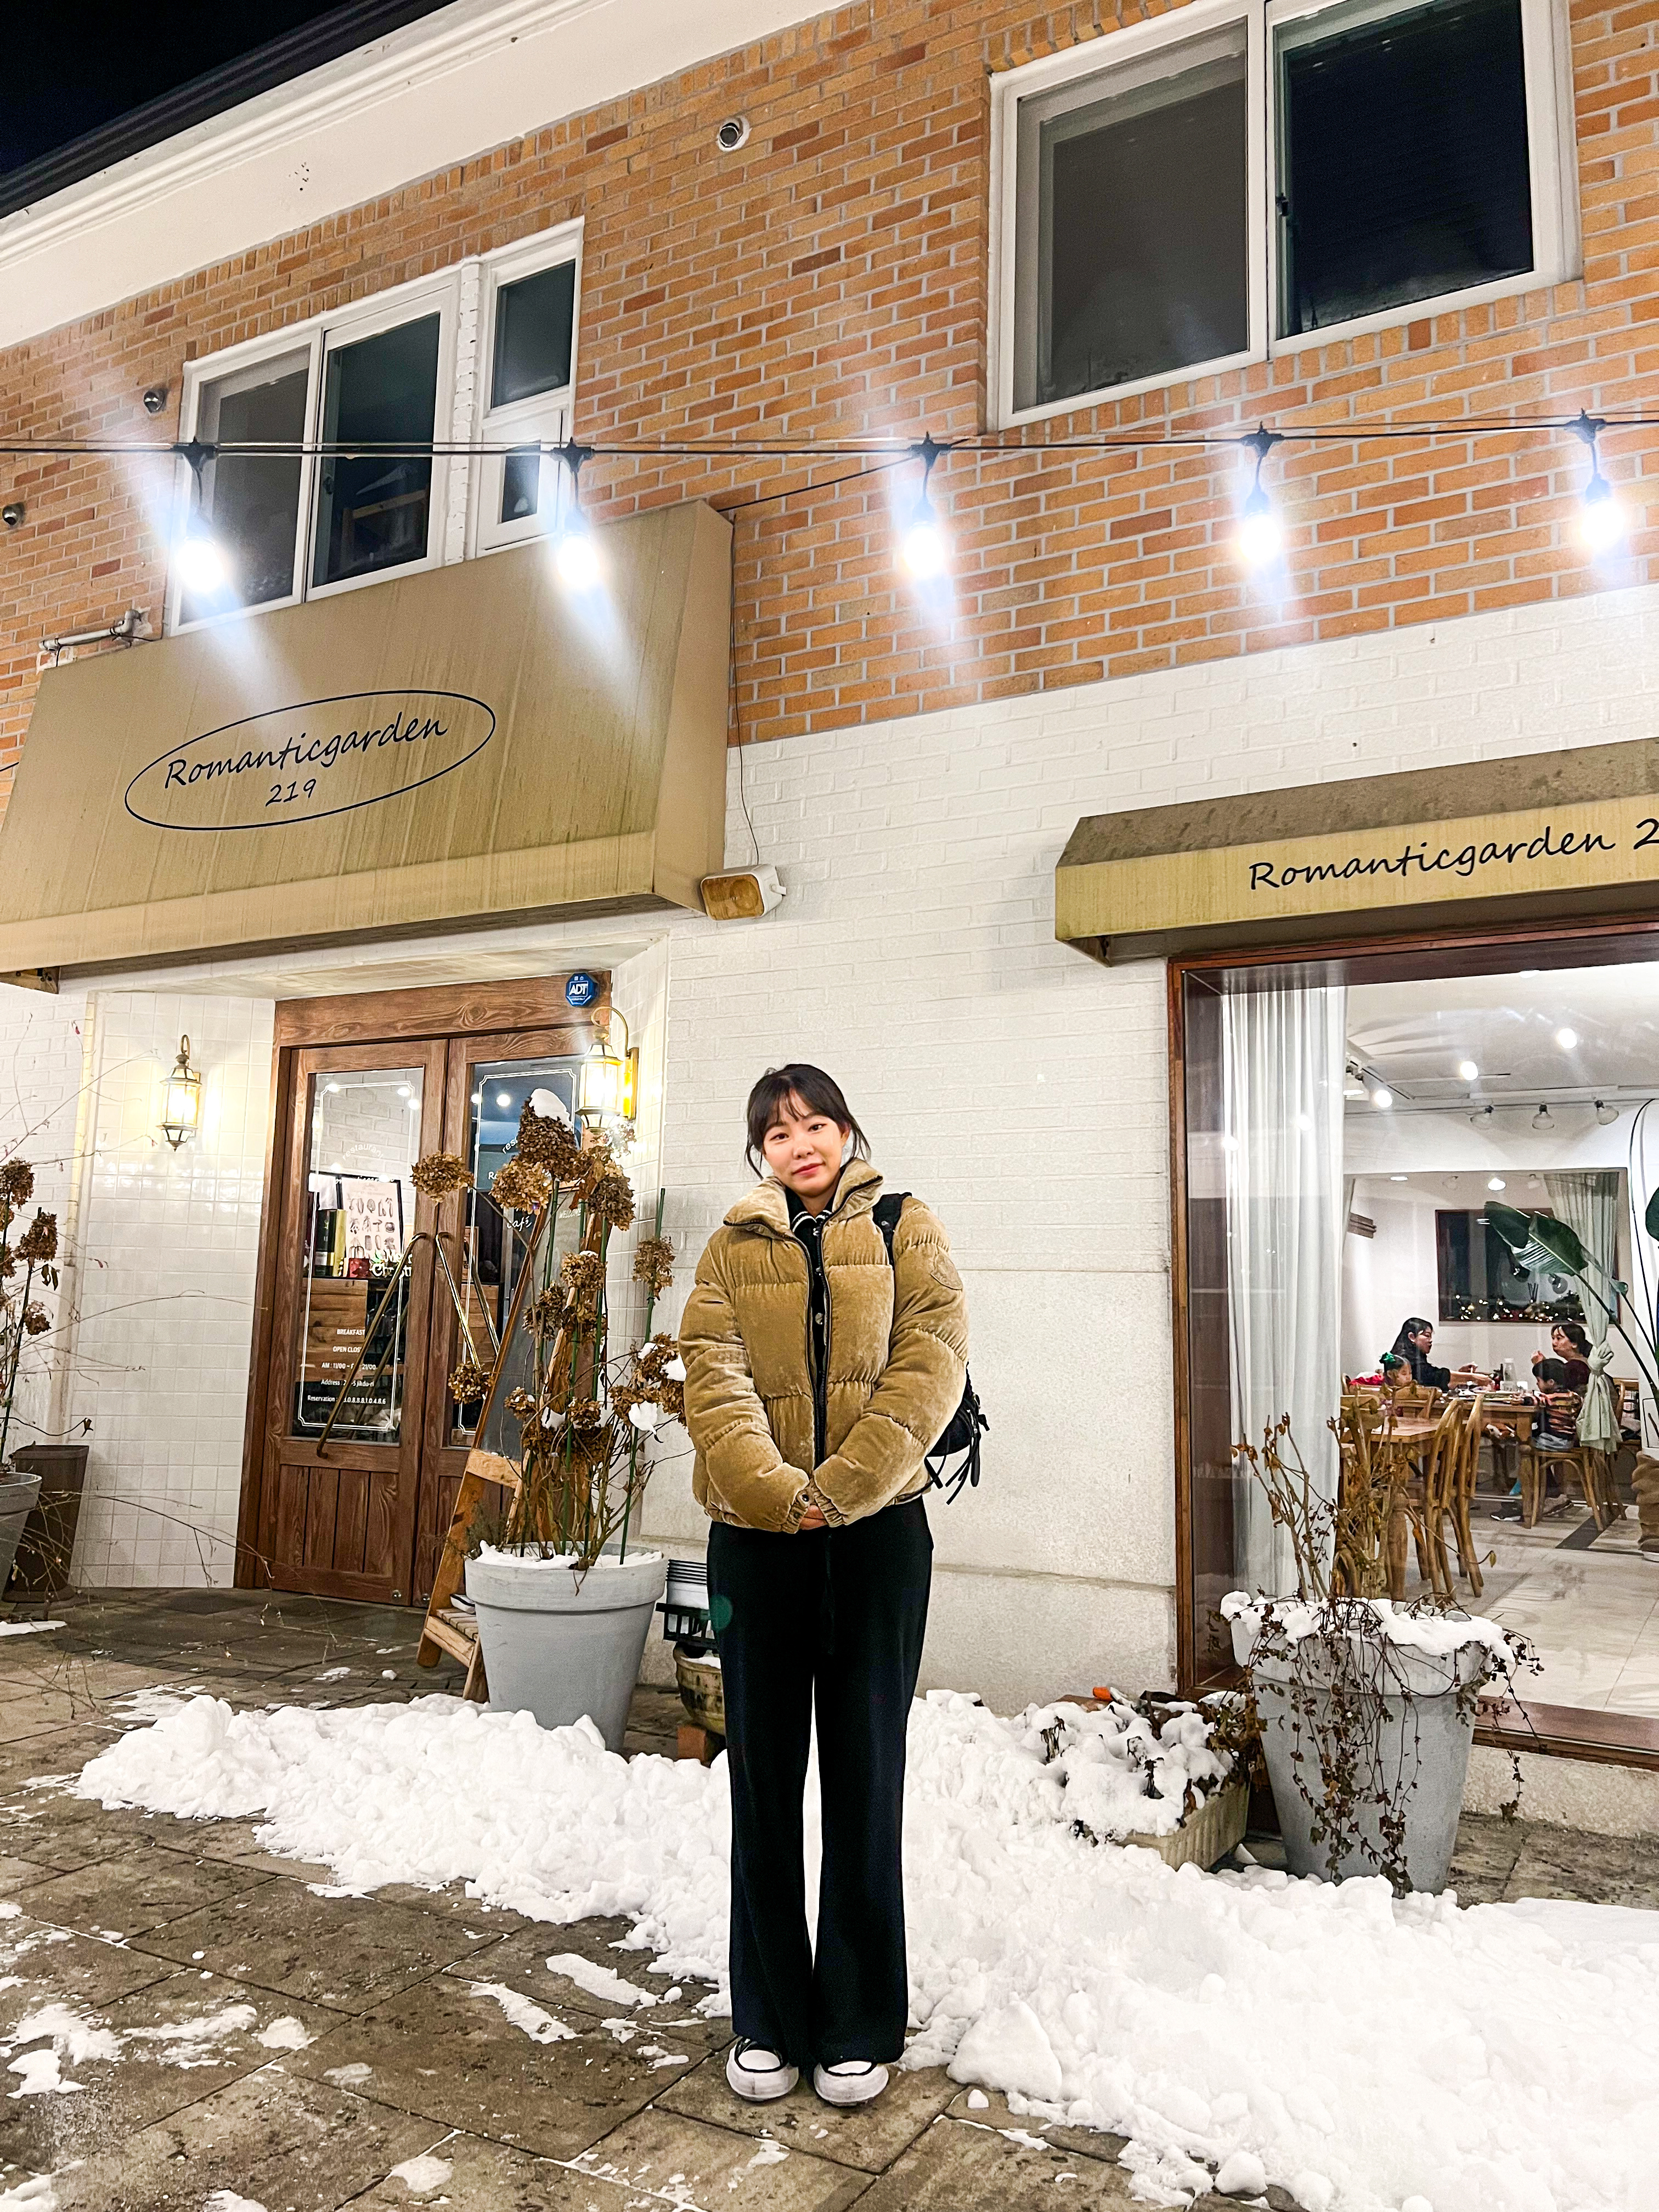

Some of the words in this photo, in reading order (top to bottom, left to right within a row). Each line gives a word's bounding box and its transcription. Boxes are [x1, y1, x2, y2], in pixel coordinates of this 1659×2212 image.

[165, 711, 448, 789] Romanticgarden
[266, 778, 317, 807] 219
[1249, 826, 1615, 890] Romanticgarden
[569, 983, 588, 995] ADT
[342, 1143, 385, 1161] restaurant
[506, 1216, 532, 1232] café
